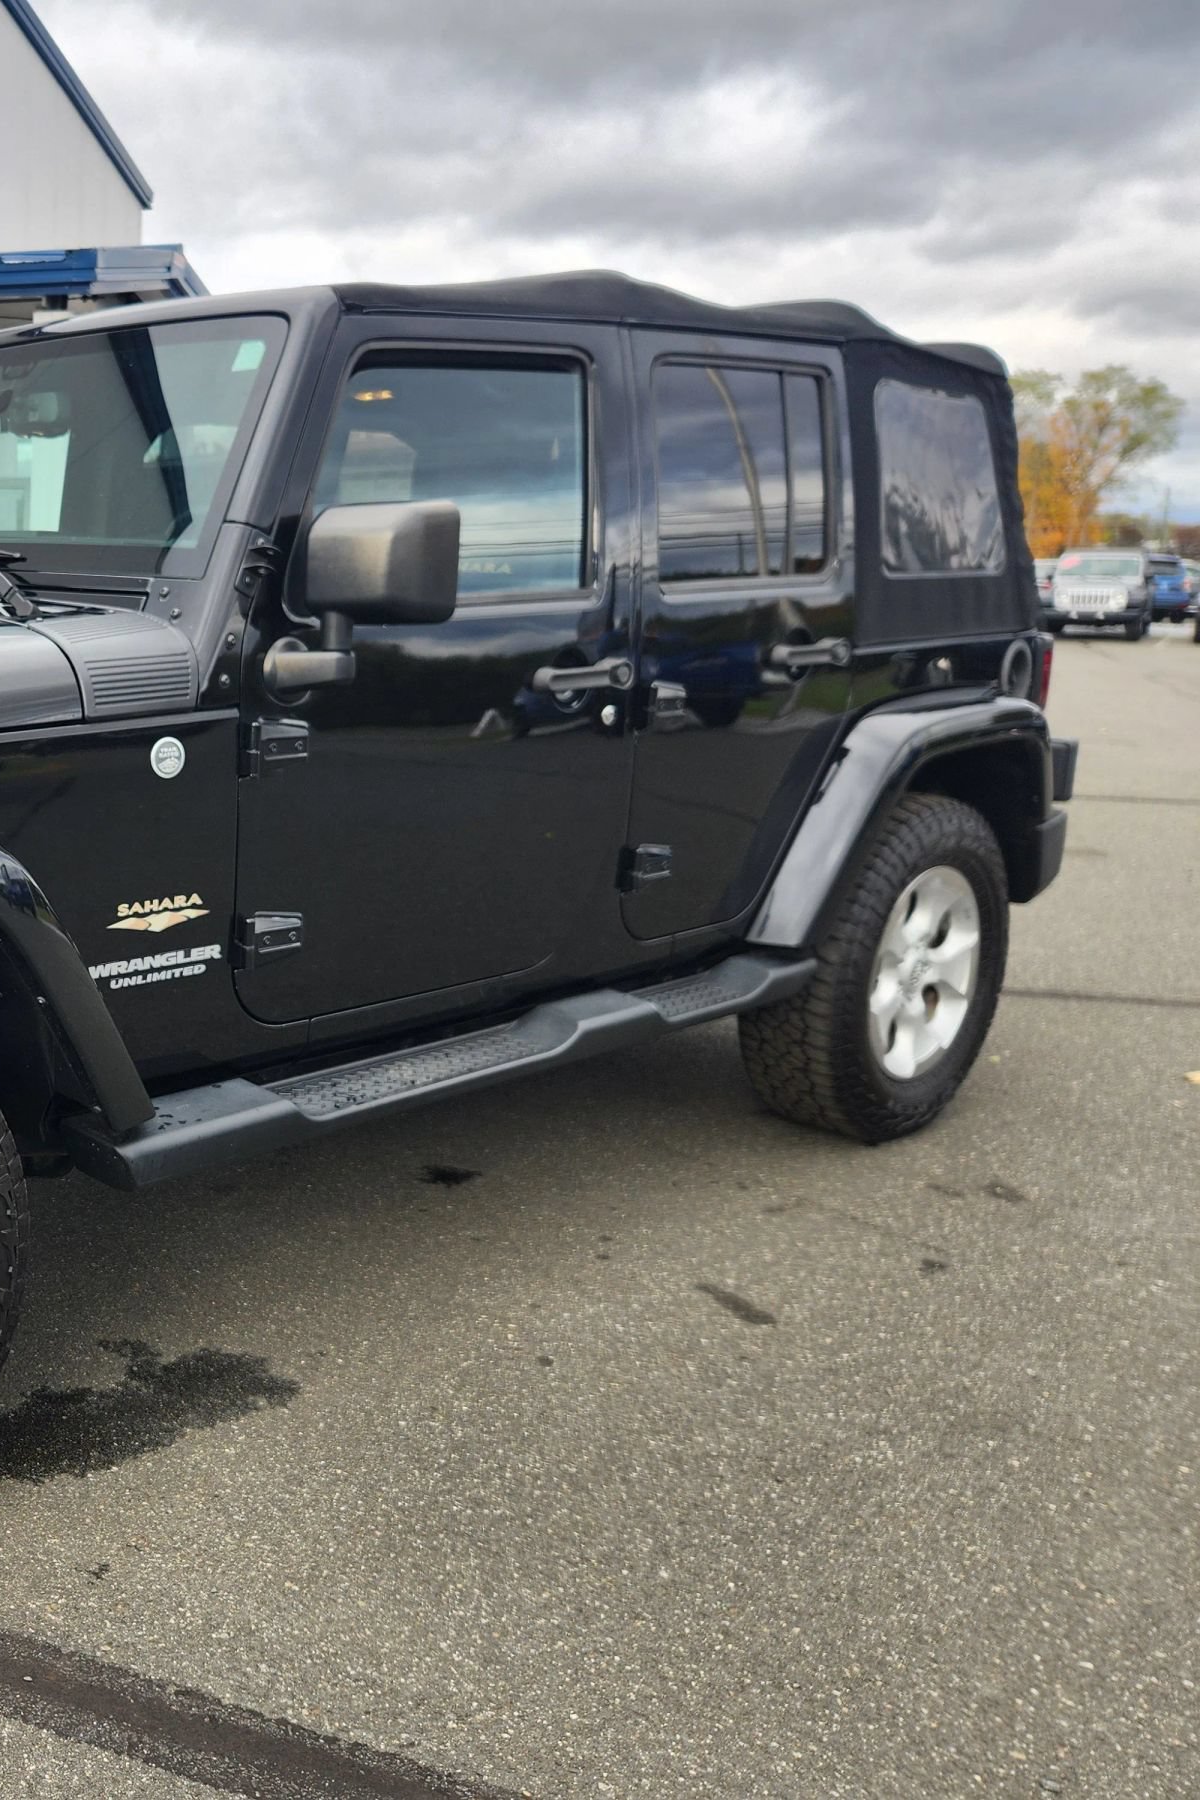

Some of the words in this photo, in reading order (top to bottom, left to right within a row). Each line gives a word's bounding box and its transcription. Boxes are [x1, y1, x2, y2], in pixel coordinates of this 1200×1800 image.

[117, 893, 203, 917] SAHARA
[88, 944, 223, 980] WRANGLER
[109, 963, 207, 990] UNLIMITED
